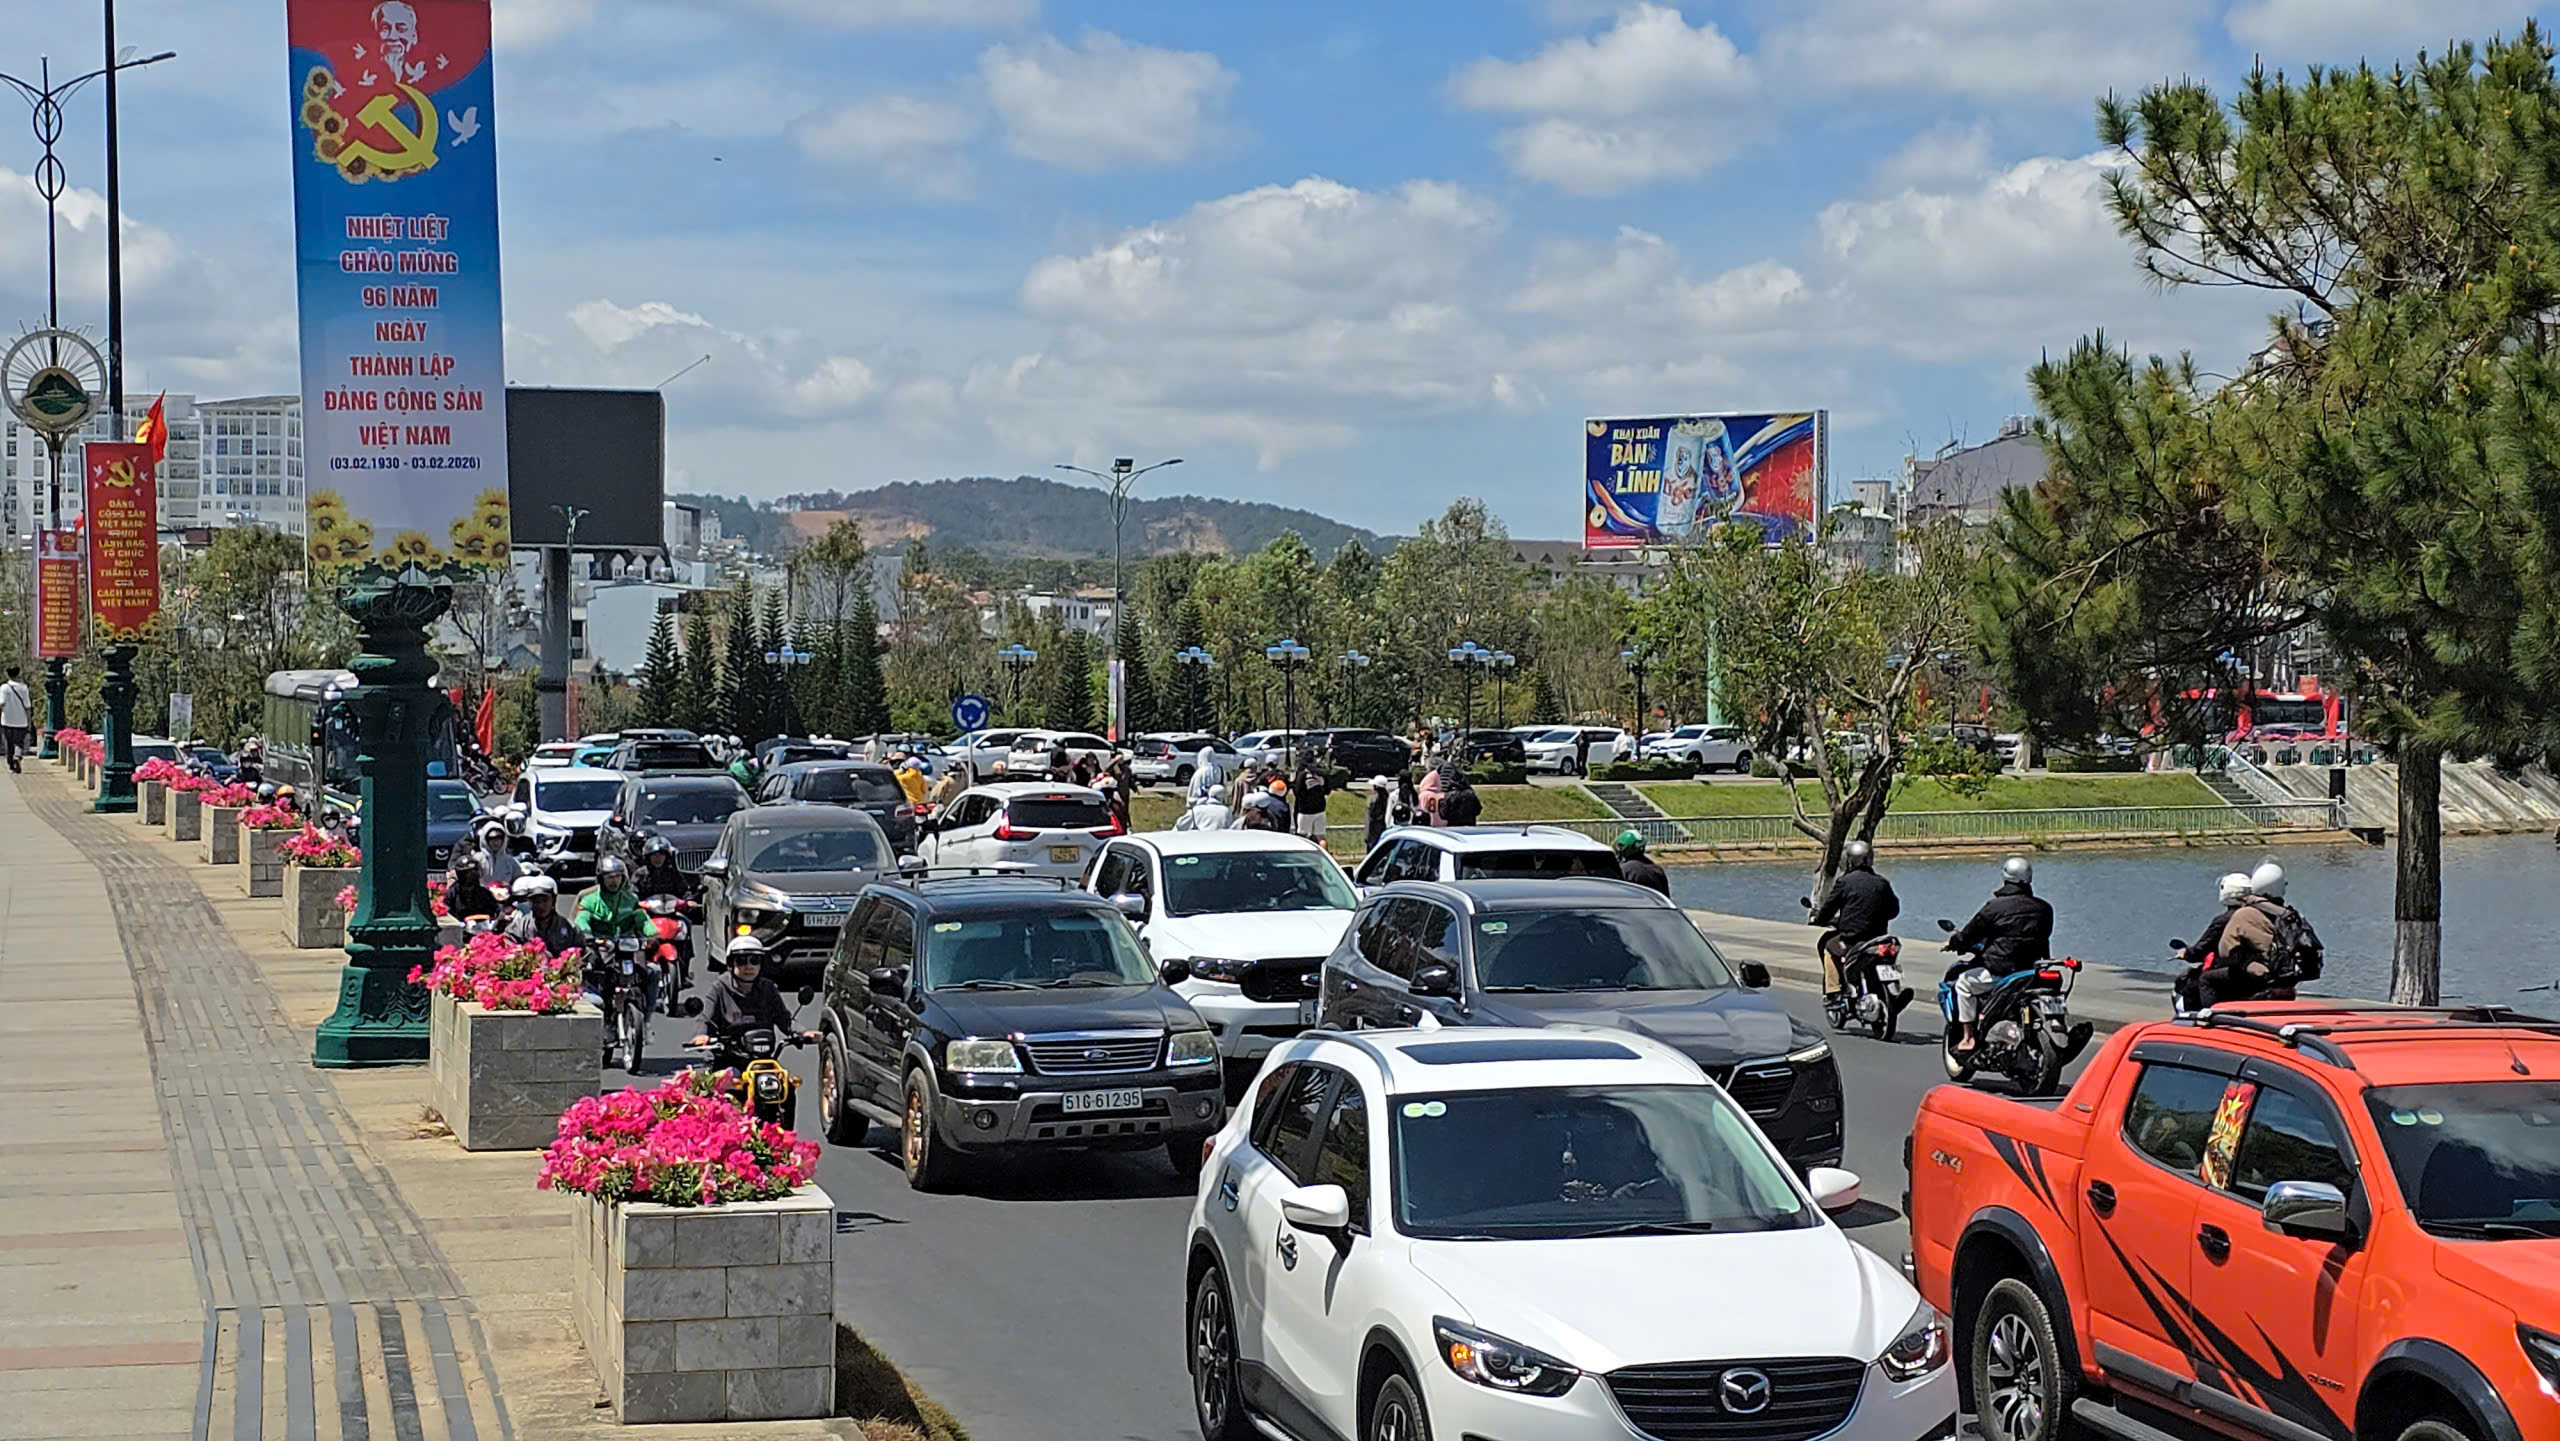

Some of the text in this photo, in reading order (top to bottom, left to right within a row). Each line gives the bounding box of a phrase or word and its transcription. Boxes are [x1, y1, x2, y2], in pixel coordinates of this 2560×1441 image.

[346, 213, 449, 244] NHIỆT LIỆT
[340, 247, 458, 273] CHÀO MỪNG
[363, 283, 438, 307] 96 NĂM
[375, 317, 427, 342] NGÀY
[350, 352, 455, 380] THÀNH LẬP
[324, 384, 483, 415] ĐẢNG CỘNG SẢN
[359, 421, 451, 450] VIỆT NAM
[330, 456, 400, 471] (03.02.1930
[1615, 465, 1661, 494] LĨNH
